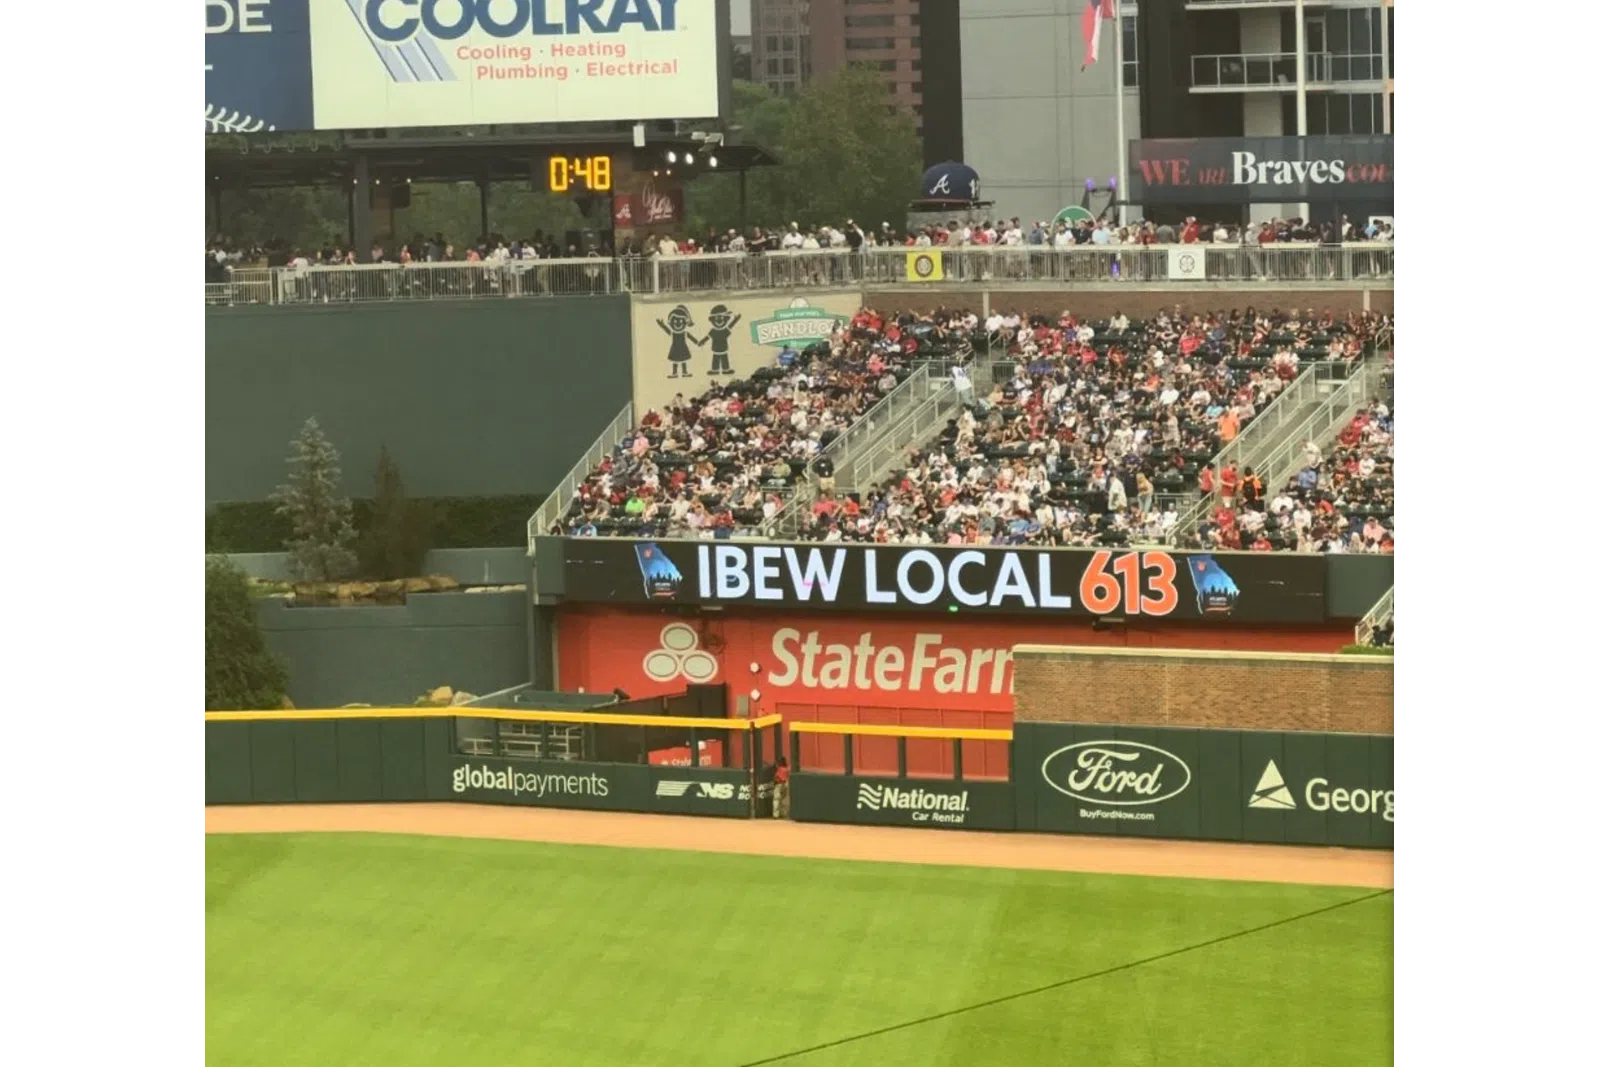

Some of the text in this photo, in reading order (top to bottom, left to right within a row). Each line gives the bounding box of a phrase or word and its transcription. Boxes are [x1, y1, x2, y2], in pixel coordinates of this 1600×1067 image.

[366, 0, 677, 41] COOLRAY
[456, 42, 627, 60] Cooling Heating
[476, 59, 678, 80] Plumbing Electrical
[549, 156, 611, 191] 0:48
[1138, 159, 1191, 187] WE
[1231, 151, 1345, 185] Braves
[760, 319, 836, 341] SANDLO
[698, 545, 1179, 616] IBEW LOCAL 613
[452, 763, 609, 798] globalpayments
[1067, 748, 1164, 796] Ford
[912, 811, 965, 824] Car Rental
[1079, 807, 1155, 821] BuyFordNow.com
